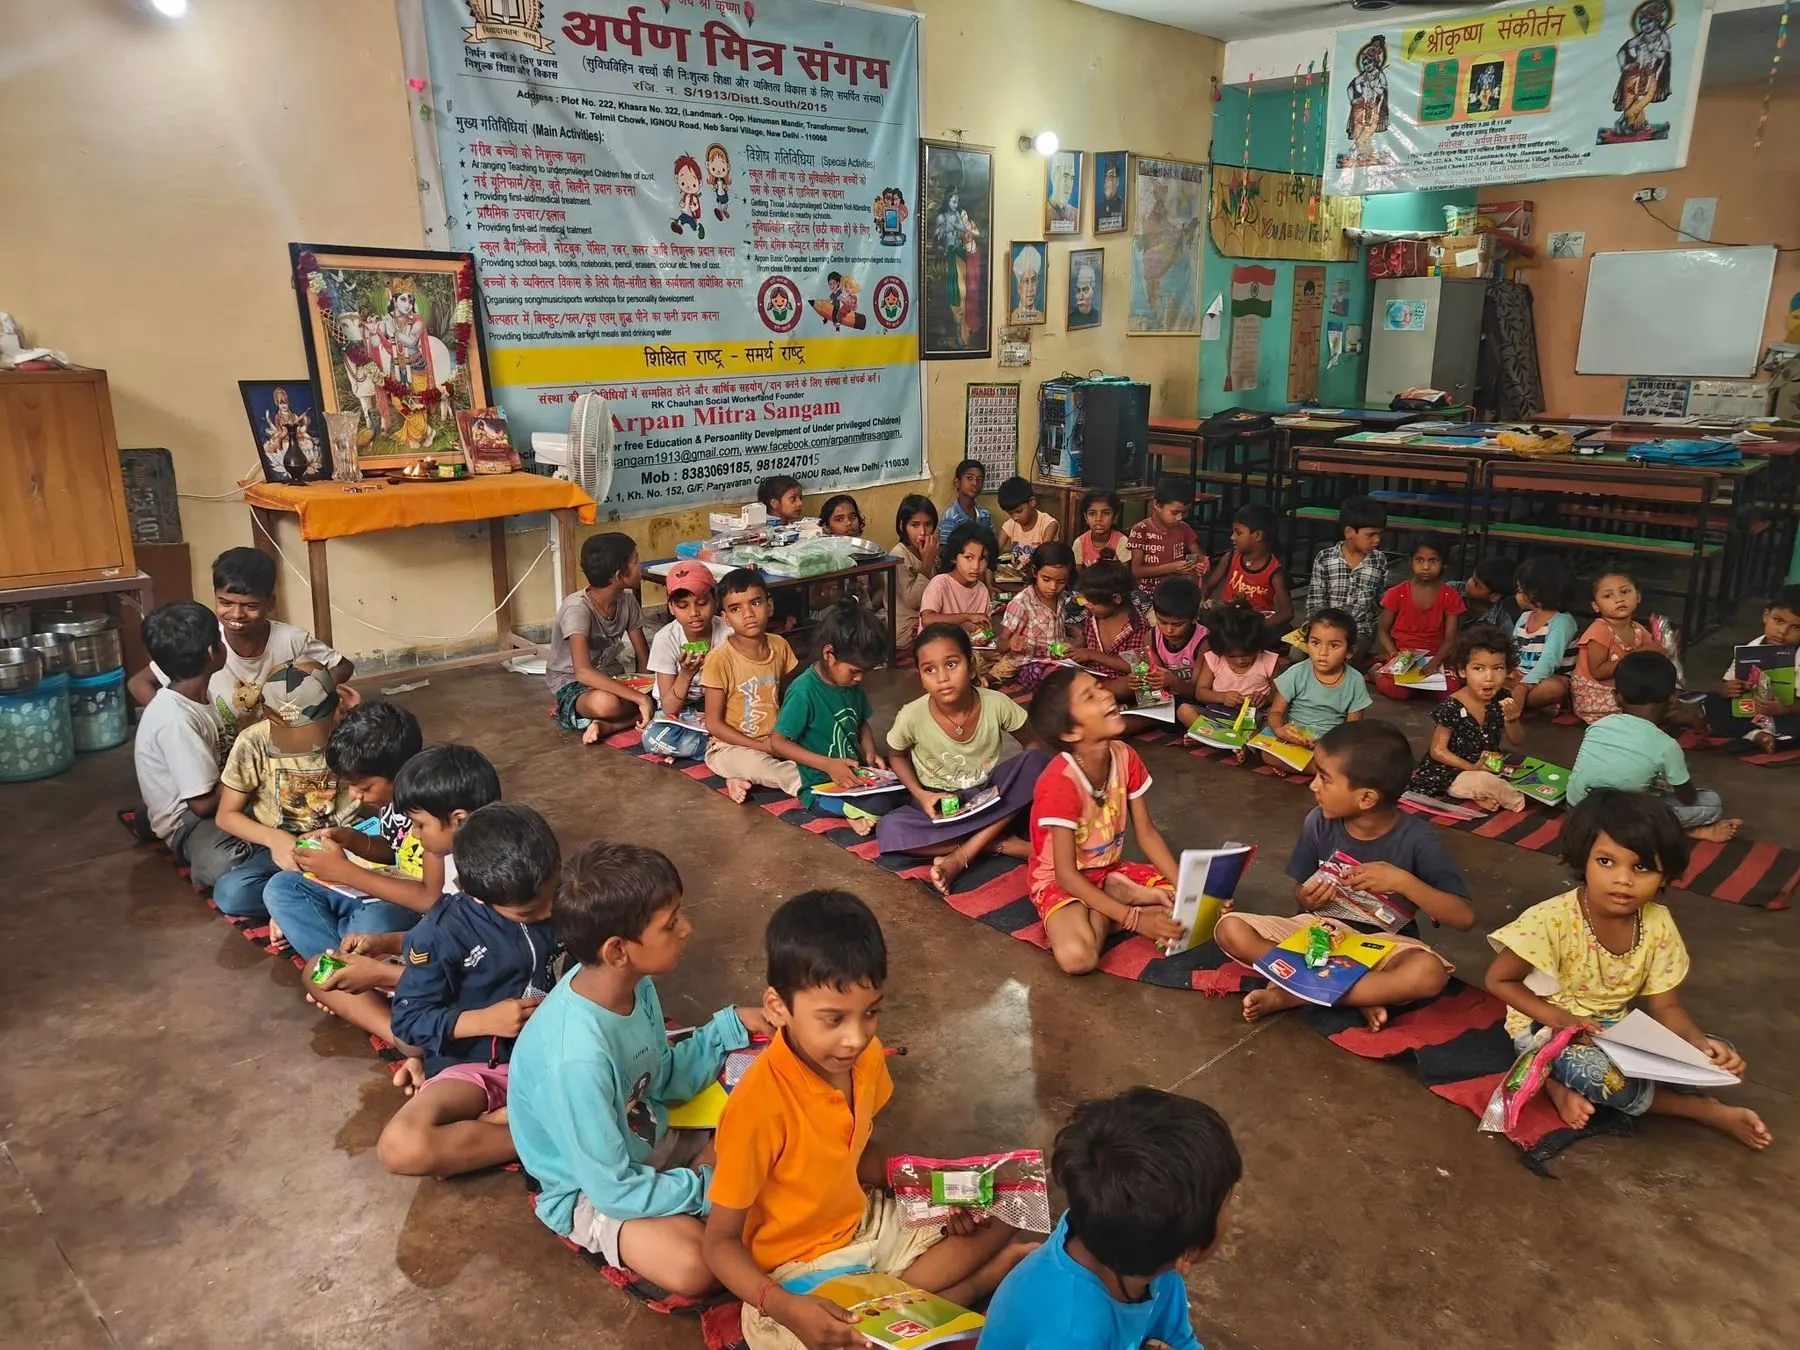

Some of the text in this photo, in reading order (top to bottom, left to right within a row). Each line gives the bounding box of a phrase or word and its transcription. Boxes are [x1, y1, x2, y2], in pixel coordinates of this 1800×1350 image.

[1427, 6, 1566, 55] श्रीकृष्ण संकीर्तन
[561, 6, 890, 89] अर्पण मित्र संगम
[663, 66, 674, 78] की
[713, 71, 732, 86] शिक्षा
[736, 75, 749, 88] और
[784, 82, 807, 96] विकास
[810, 85, 817, 97] के
[821, 86, 834, 101] लिए
[517, 89, 553, 103] Address
[561, 95, 578, 106] Plot
[582, 98, 596, 107] No.
[599, 99, 617, 110] 222,
[618, 100, 646, 113] Khasra
[649, 104, 662, 113] No.
[665, 106, 681, 117] 322,
[682, 107, 723, 121] (Landmark
[729, 113, 745, 123] Opp.
[747, 115, 779, 128] Hanuman
[781, 118, 806, 130] Mandir,
[807, 120, 846, 133] Transformer
[575, 111, 588, 120] Nr.
[617, 114, 649, 126] Chowk,
[650, 117, 677, 128] IGNOU
[679, 120, 701, 131] Road,
[703, 122, 718, 132] Neb
[721, 123, 738, 134] Sarai
[740, 125, 765, 138] Village,
[767, 128, 781, 138] New
[783, 129, 799, 139] Delhi
[456, 117, 478, 134] मुख्य
[533, 123, 557, 139] (Main
[508, 162, 538, 174] Teaching
[474, 191, 507, 203] Providing
[477, 222, 509, 233] Providing
[481, 258, 514, 269] Providing
[516, 259, 538, 268] school
[488, 332, 521, 342] Providing
[644, 341, 806, 370] शिक्षित राष्ट्र समर्थ राष्ट्र
[651, 401, 664, 409] RK
[667, 398, 704, 408] Chauhan
[706, 396, 729, 406] Social
[776, 391, 805, 401] Founder
[611, 400, 841, 436] Arpan Mitra Sangam
[624, 440, 643, 451] free
[647, 437, 692, 449] Education
[803, 424, 811, 434] of
[813, 423, 834, 434] Under
[836, 418, 870, 433] privileged
[627, 489, 645, 500] Kh.
[647, 487, 663, 498] No.
[666, 484, 684, 497] 152,
[687, 481, 704, 494] G/F,
[707, 477, 752, 492] Paryavaran
[821, 467, 842, 478] Road,
[844, 464, 860, 474] New
[861, 461, 880, 471] Delhi
[641, 453, 820, 485] Mob 8383069185, 9818247015
